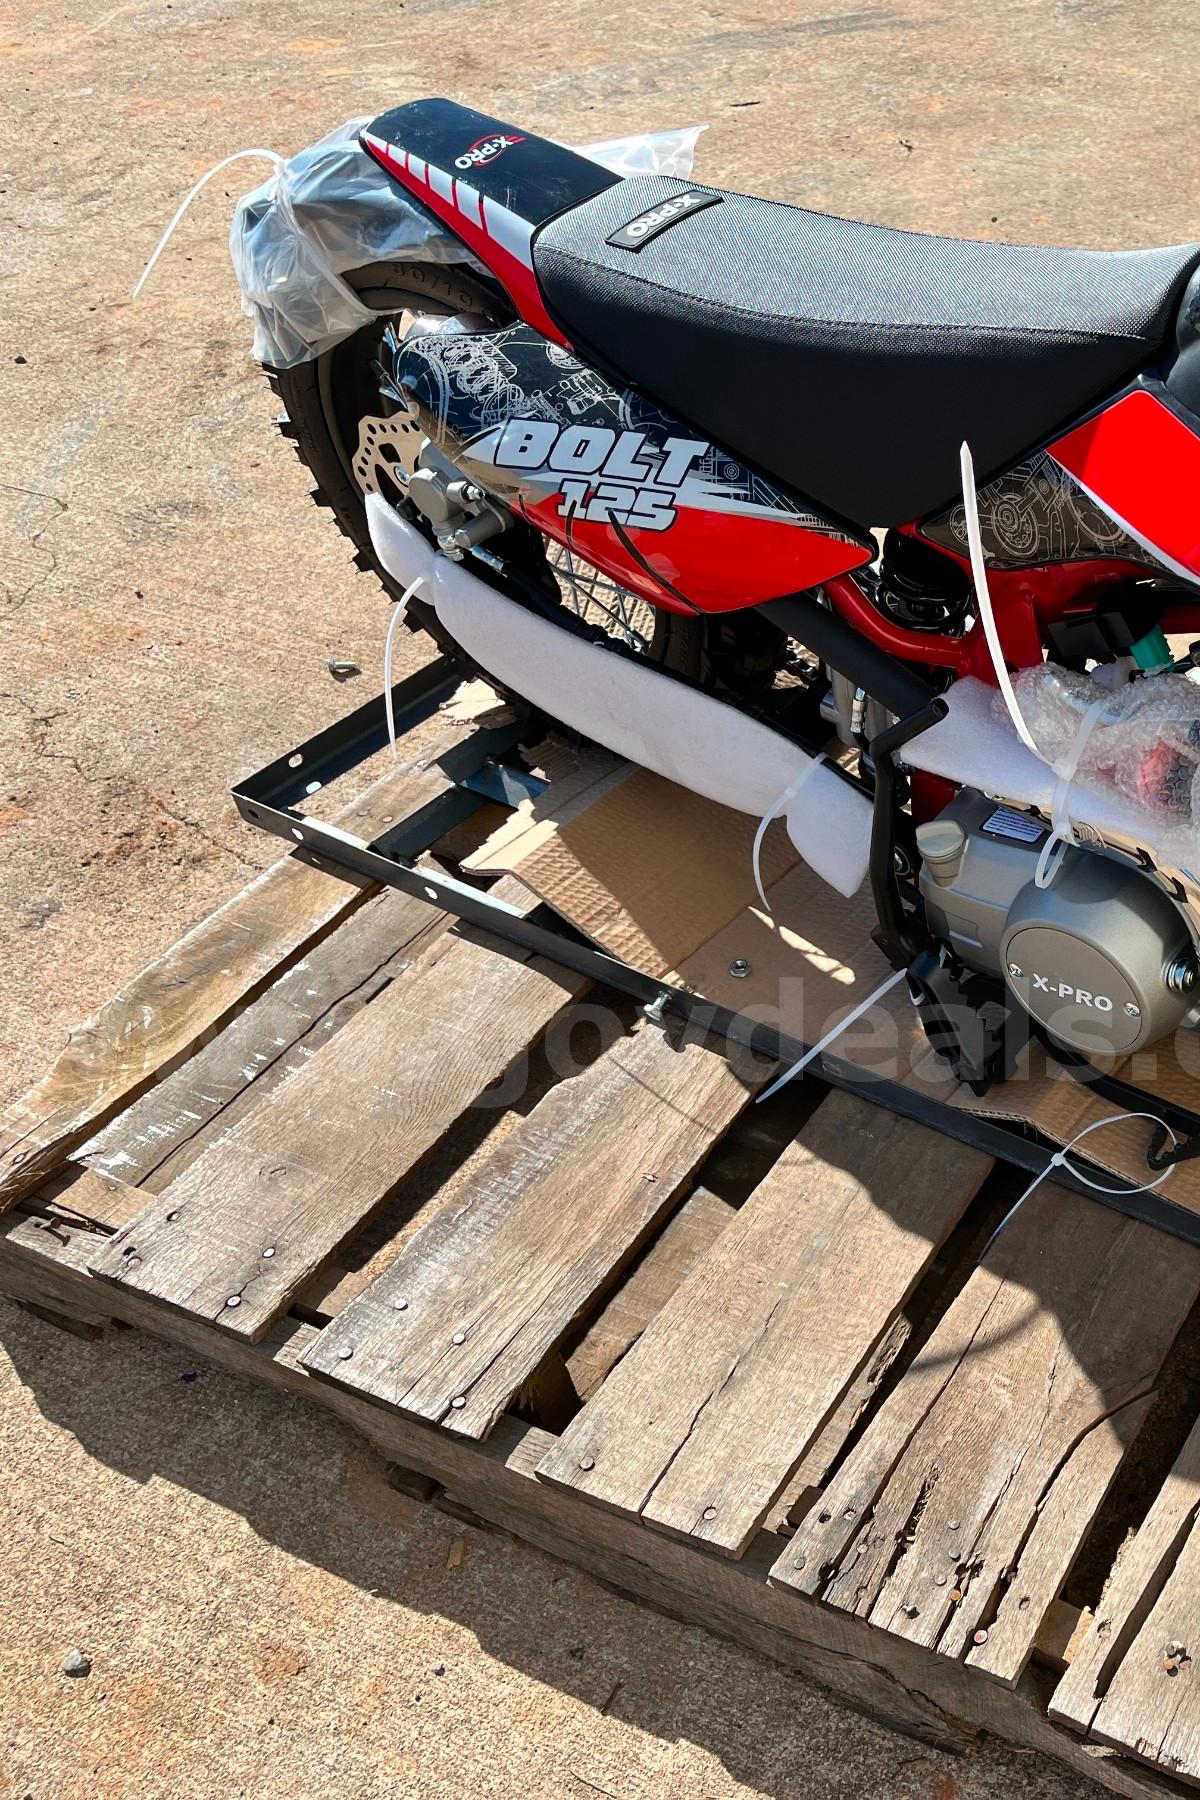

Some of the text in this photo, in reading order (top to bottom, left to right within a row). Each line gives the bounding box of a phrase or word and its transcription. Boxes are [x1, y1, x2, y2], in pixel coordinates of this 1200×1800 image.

[455, 135, 514, 170] X-PRO
[626, 194, 702, 237] X-PRO
[494, 416, 712, 488] BOLT
[556, 478, 678, 533] 125
[1032, 972, 1113, 1012] X-PRO
